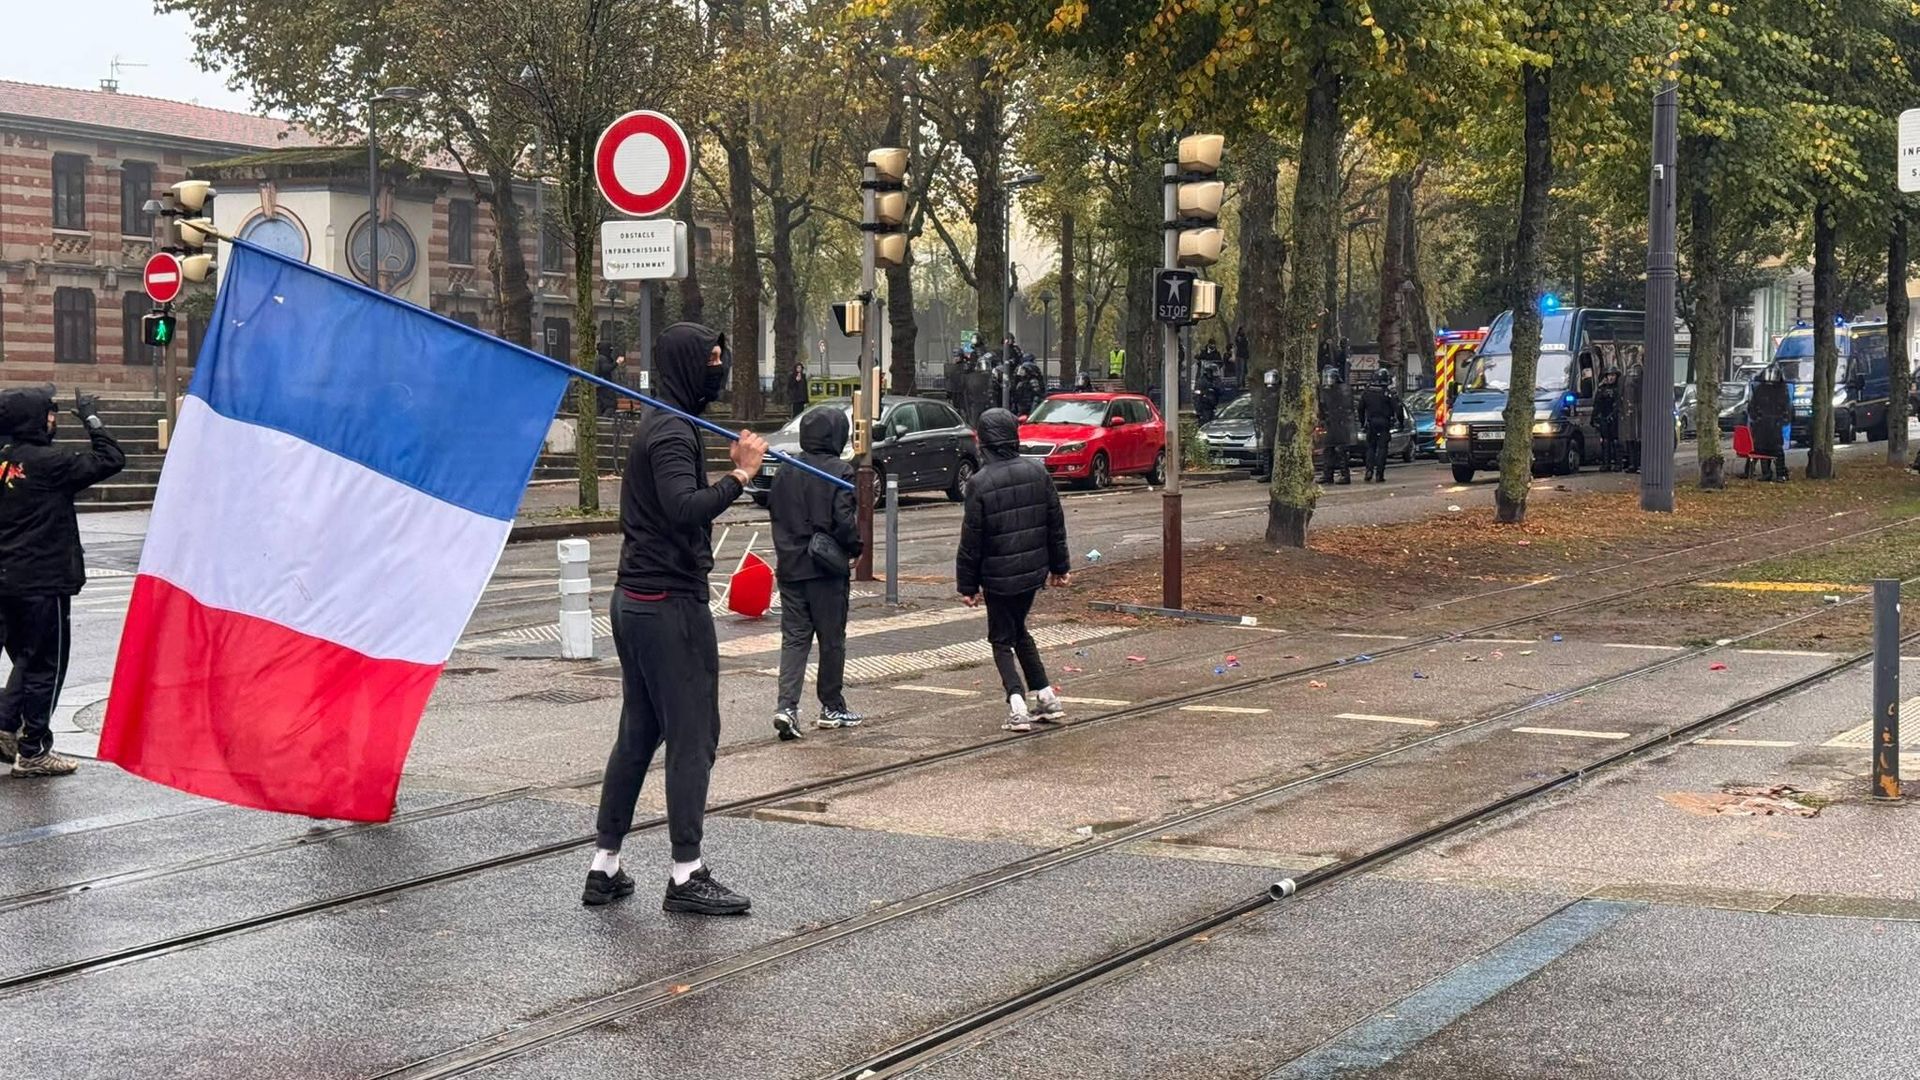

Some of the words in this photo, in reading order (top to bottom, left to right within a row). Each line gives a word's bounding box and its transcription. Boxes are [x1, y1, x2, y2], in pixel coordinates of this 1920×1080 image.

[620, 231, 655, 239] OBSTACLE
[604, 246, 670, 255] INFRANCHISSABLE
[632, 261, 665, 269] TRAMWAY
[1159, 304, 1188, 318] STOP
